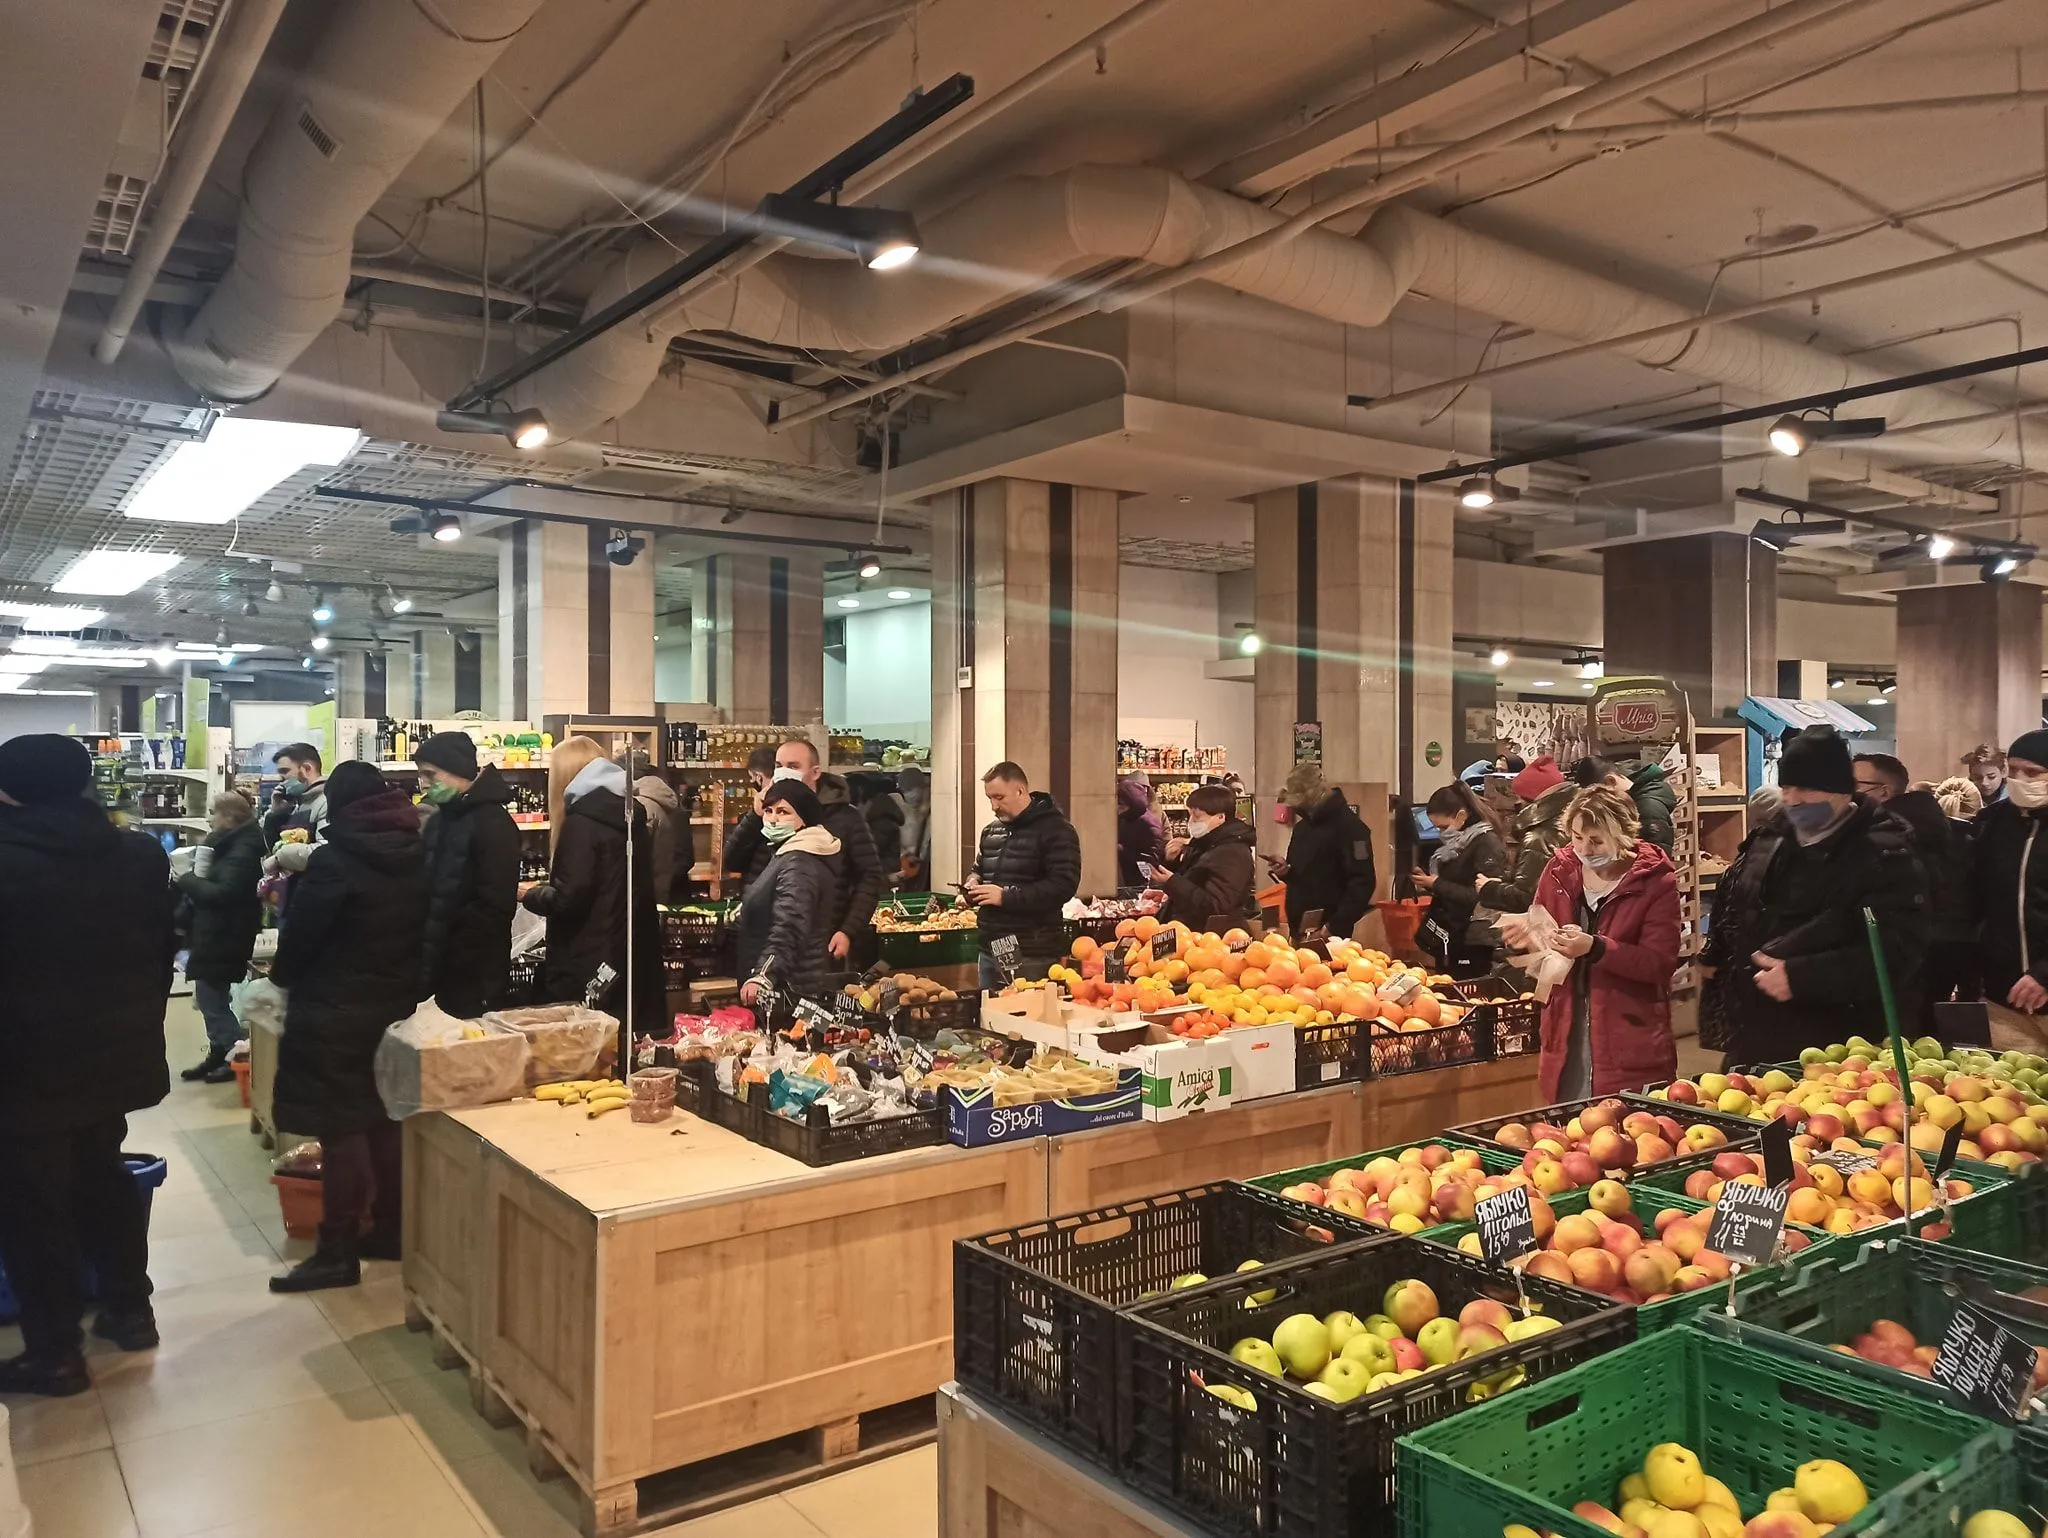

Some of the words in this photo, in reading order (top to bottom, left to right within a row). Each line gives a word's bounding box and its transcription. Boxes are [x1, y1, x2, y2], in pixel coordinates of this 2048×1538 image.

[1177, 1068, 1213, 1087] Amica
[1475, 1187, 1527, 1225] ЯБЛУКО
[1721, 1180, 1787, 1213] ЯБЛУКО
[1483, 1207, 1533, 1240] ЛІГОЛЬД
[1933, 1308, 1976, 1385] ЯБЛУКО
[1952, 1334, 1990, 1401] ГОЛДЕН
